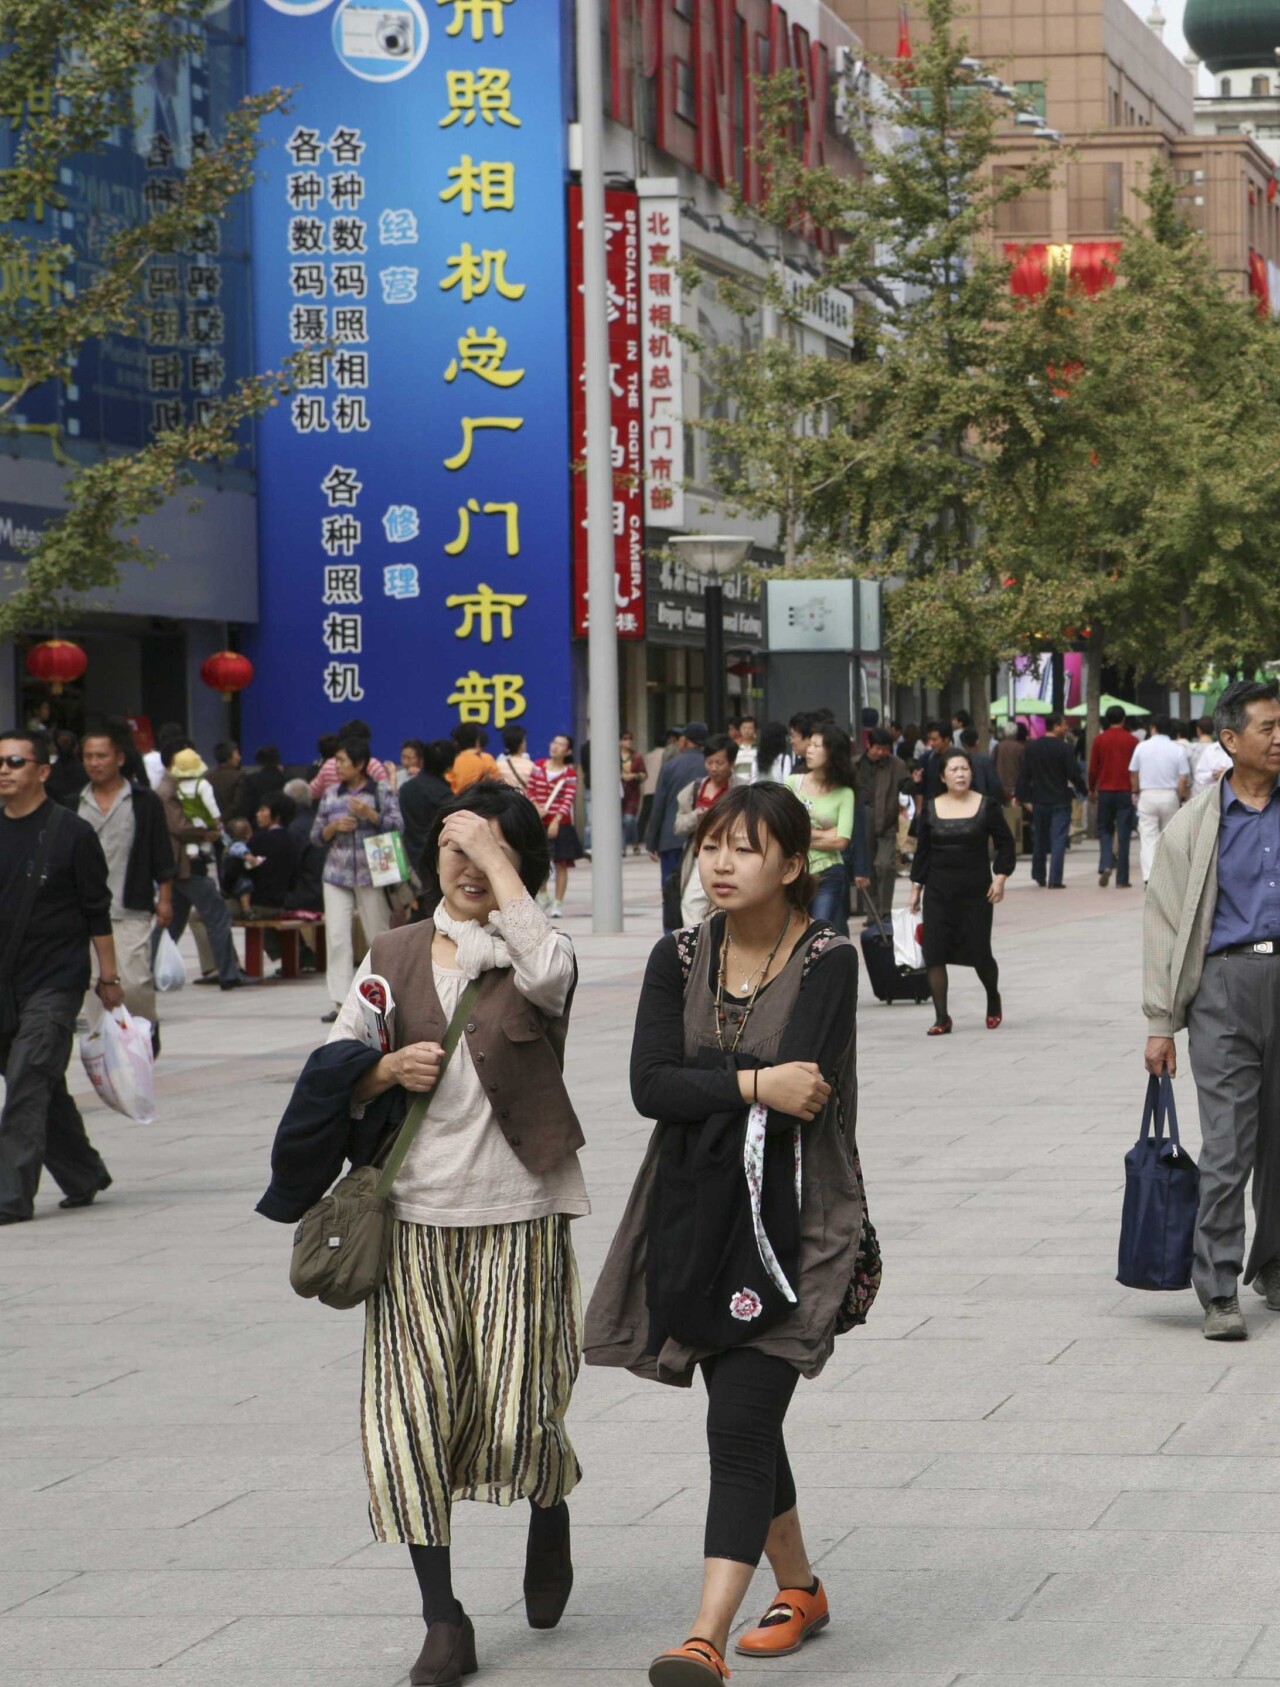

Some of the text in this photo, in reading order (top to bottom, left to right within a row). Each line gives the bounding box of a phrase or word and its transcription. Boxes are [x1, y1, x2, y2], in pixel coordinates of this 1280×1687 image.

[287, 126, 328, 433] 各种数码摄相机
[328, 125, 371, 433] 各种数码照相机
[378, 208, 419, 305] 经营
[624, 209, 638, 325] SPECIALIZE
[626, 340, 638, 361] IN
[627, 372, 639, 408] THE
[646, 211, 674, 510] 北京照相机总厂门市部
[321, 464, 364, 703] 各种照相机
[382, 505, 421, 600] 修理
[629, 514, 642, 600] CAMERA
